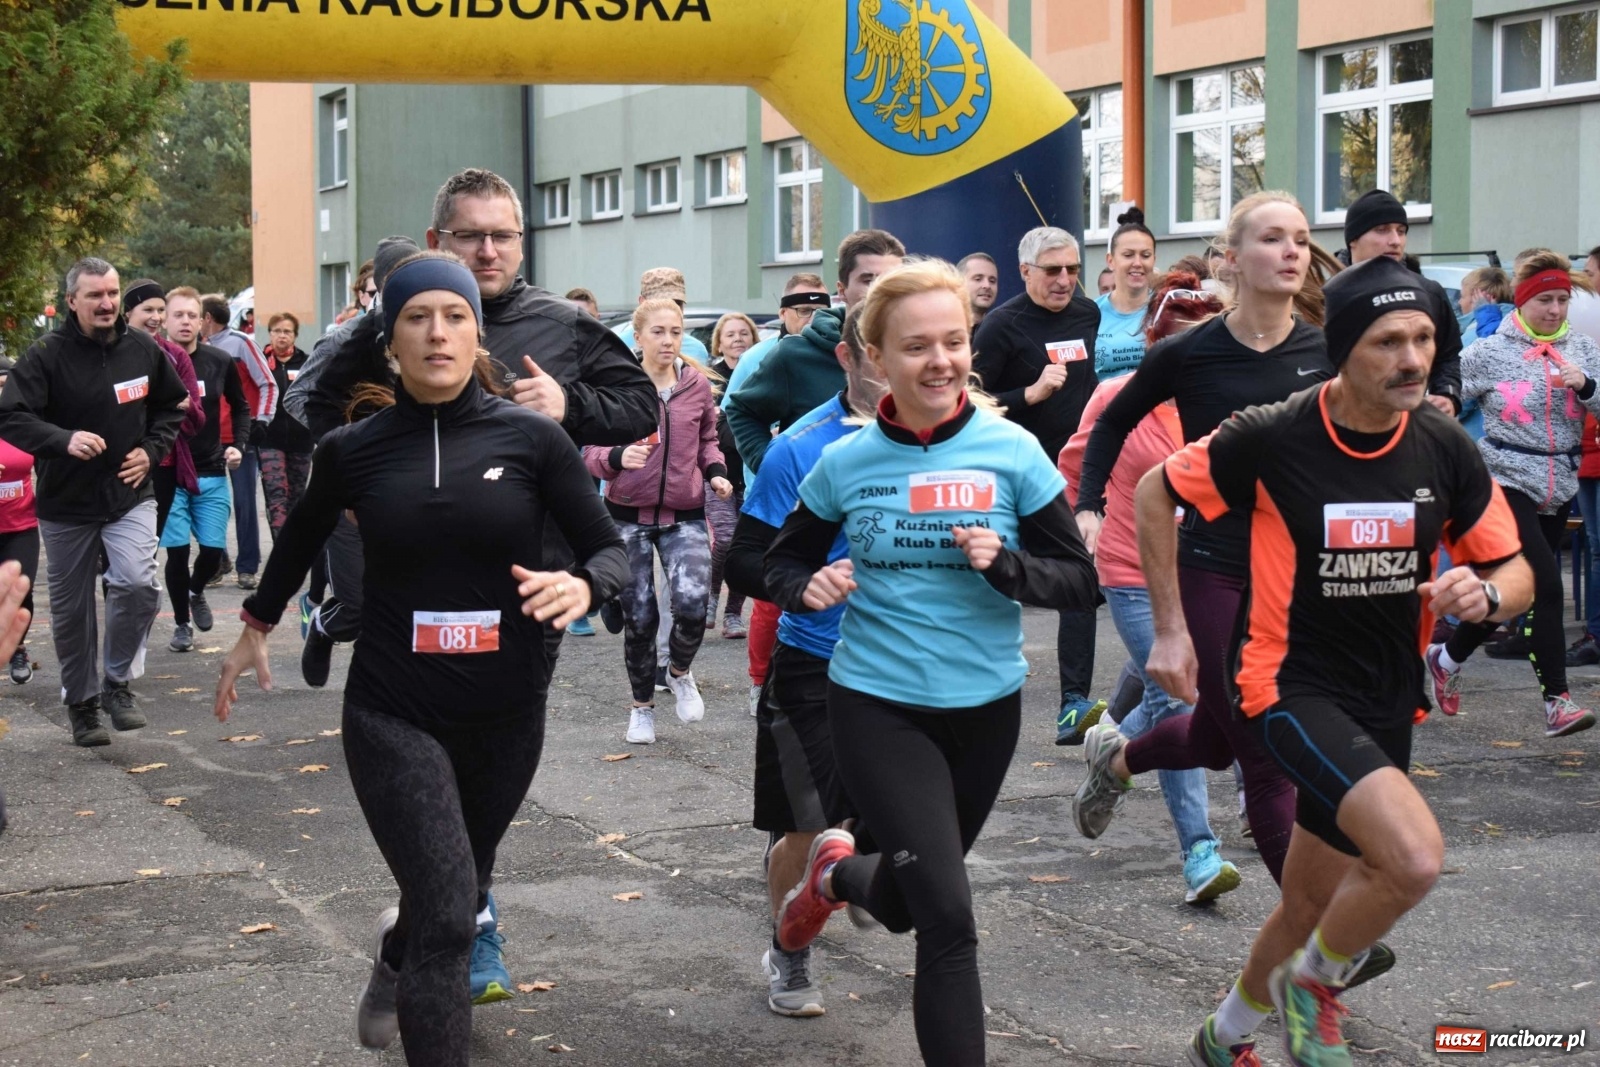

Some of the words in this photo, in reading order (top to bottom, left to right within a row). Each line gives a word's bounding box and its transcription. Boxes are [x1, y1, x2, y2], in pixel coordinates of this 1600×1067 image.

[1372, 291, 1416, 307] SELECT
[1057, 348, 1077, 360] 040
[127, 385, 144, 399] 015
[483, 467, 504, 480] 4F
[933, 484, 974, 508] 110
[1351, 519, 1390, 544] 091
[893, 537, 935, 549] Klub
[1318, 551, 1419, 579] ZAWISZA
[1321, 582, 1368, 597] STARA
[1368, 577, 1416, 595] KUŹNIA
[438, 626, 477, 650] 081
